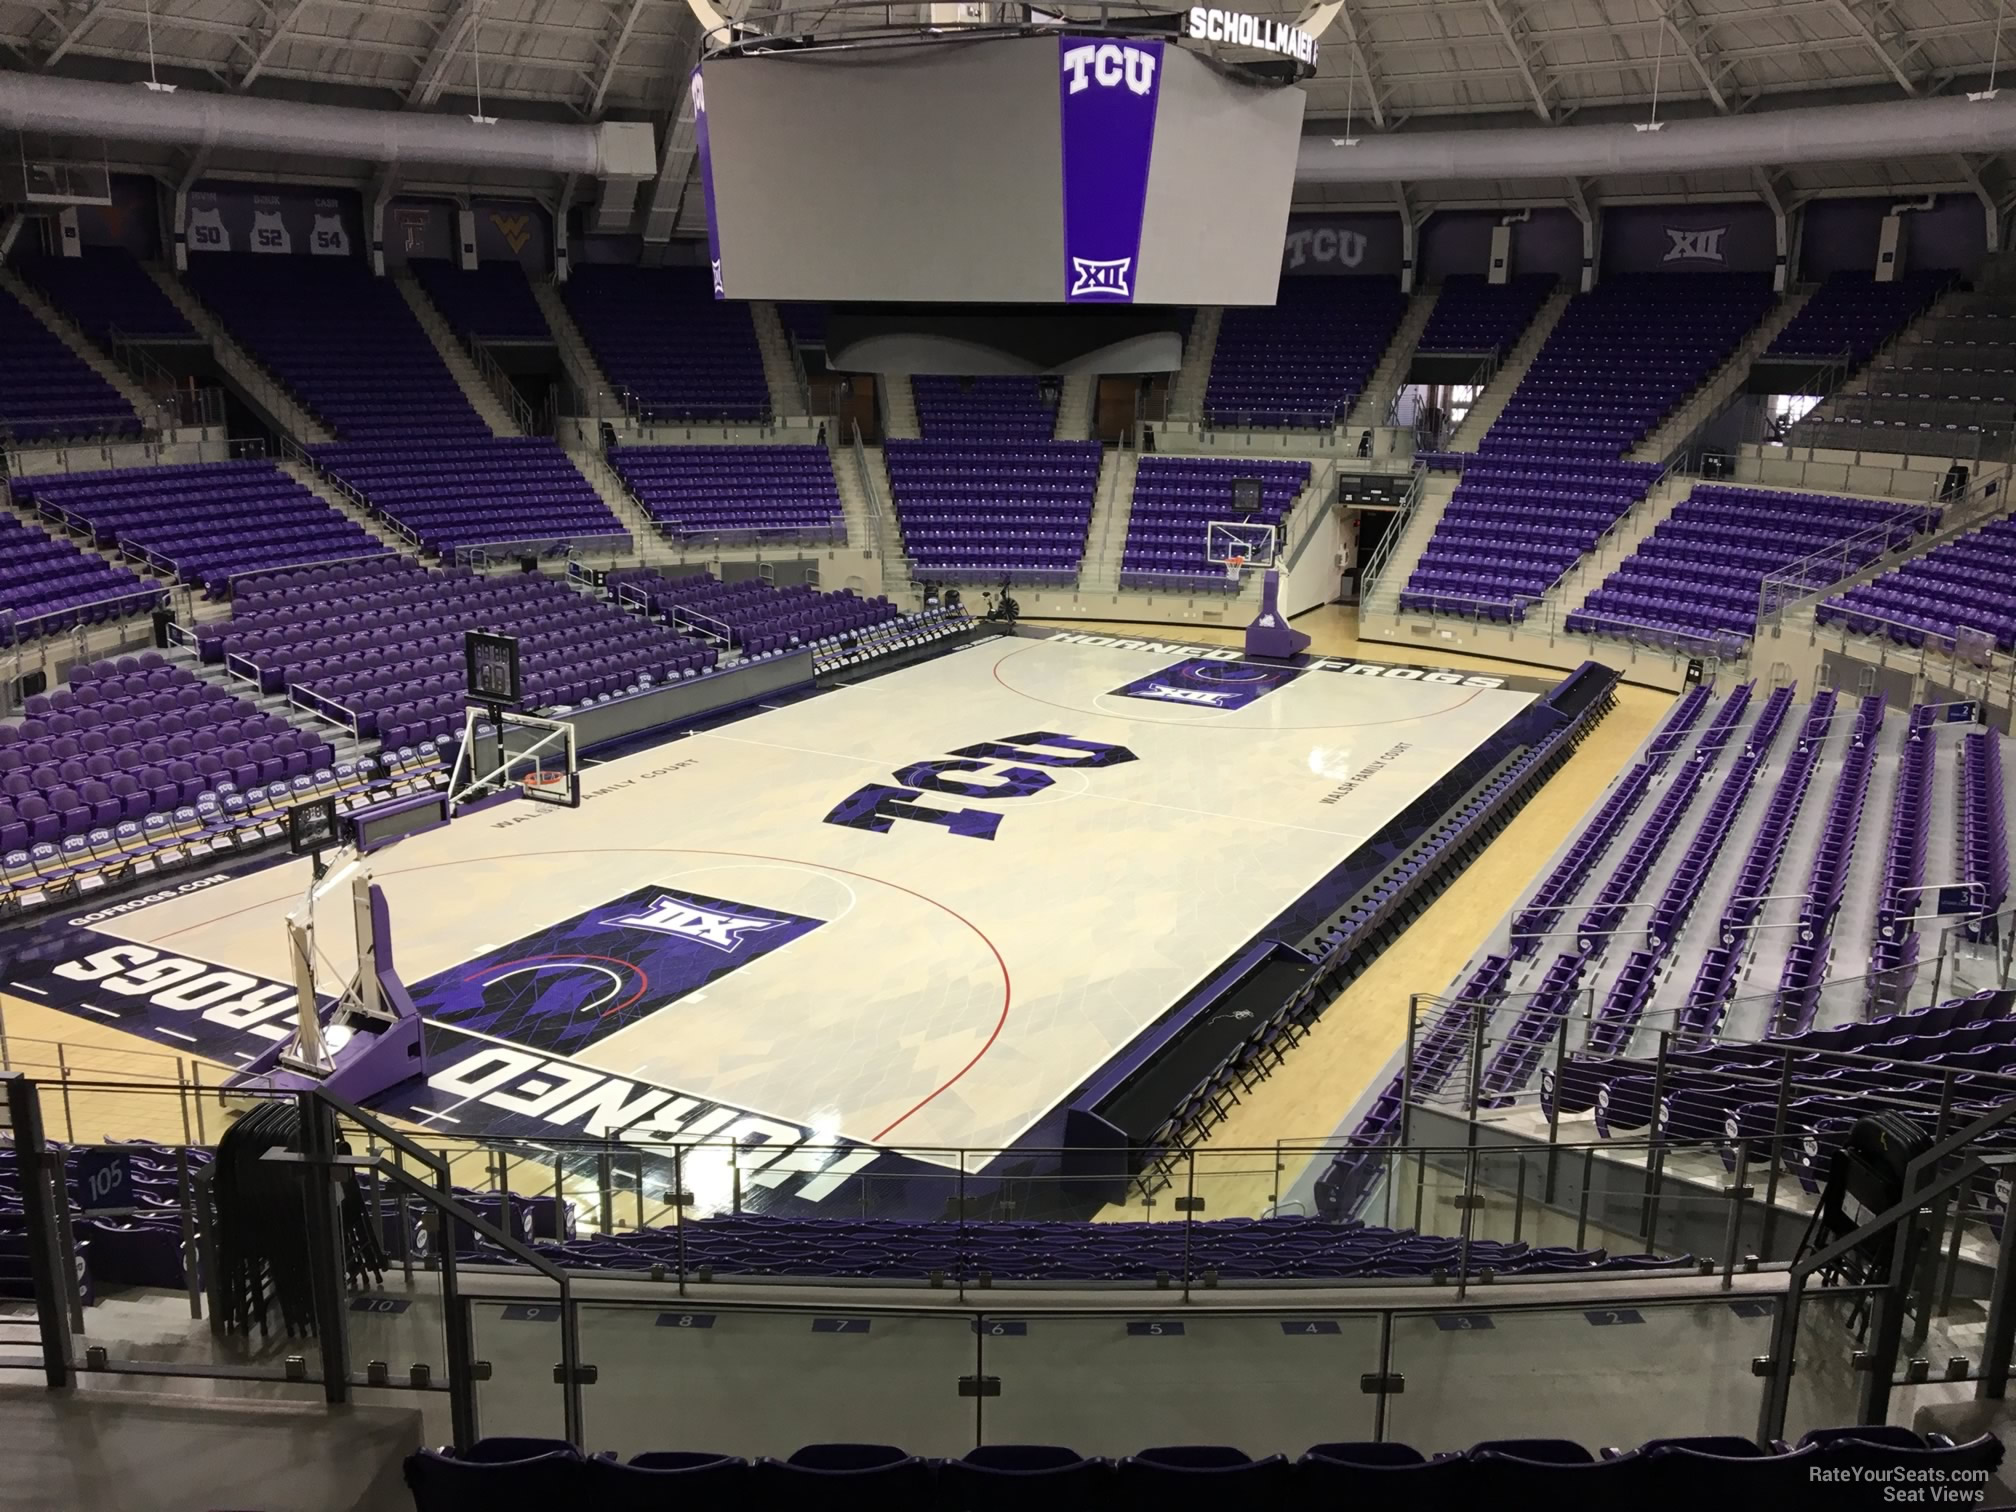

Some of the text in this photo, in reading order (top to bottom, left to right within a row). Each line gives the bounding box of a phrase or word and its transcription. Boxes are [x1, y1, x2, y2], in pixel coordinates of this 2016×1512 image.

[1189, 6, 1312, 64] SCHOLLMAIER
[1064, 44, 1155, 95] TCU
[195, 226, 221, 244] 50
[258, 229, 283, 246] 52
[317, 231, 341, 248] 54
[1287, 228, 1367, 268] TCU
[1046, 633, 1244, 660] HORNED
[1308, 658, 1506, 688] FROGS
[1963, 706, 1969, 715] 2
[400, 749, 412, 758] TCU
[420, 744, 433, 752] TCU
[359, 760, 374, 769] TCU
[383, 754, 397, 763] TCU
[316, 771, 331, 781] TCU
[337, 765, 352, 775] TCU
[1319, 742, 1413, 805] WALSH FAMILY COURT
[294, 777, 310, 787] TCU
[581, 779, 635, 800] AMILY
[641, 758, 700, 779] COURT
[218, 784, 234, 793] TCU
[270, 783, 286, 793] TCU
[822, 731, 1140, 841] TCU
[248, 790, 263, 800] TCU
[197, 802, 214, 812] TCU
[226, 797, 243, 807] TCU
[176, 809, 194, 819] TCU
[146, 815, 164, 826] TCU
[119, 823, 136, 834] TCU
[91, 831, 109, 842] TCU
[65, 838, 84, 849] TCU
[33, 845, 53, 857] TCU
[6, 853, 27, 865] TCU
[68, 874, 231, 926] GOFROGS.COM
[1961, 891, 1969, 903] 3
[88, 1159, 123, 1202] 105
[367, 1300, 394, 1312] 10
[526, 1308, 540, 1320] 9
[1606, 1312, 1623, 1324] 2
[678, 1315, 693, 1327] 8
[836, 1320, 848, 1332] 7
[1459, 1317, 1473, 1330] 3
[992, 1322, 1005, 1336] 6
[1150, 1323, 1163, 1336] 5
[1306, 1323, 1319, 1335] 4
